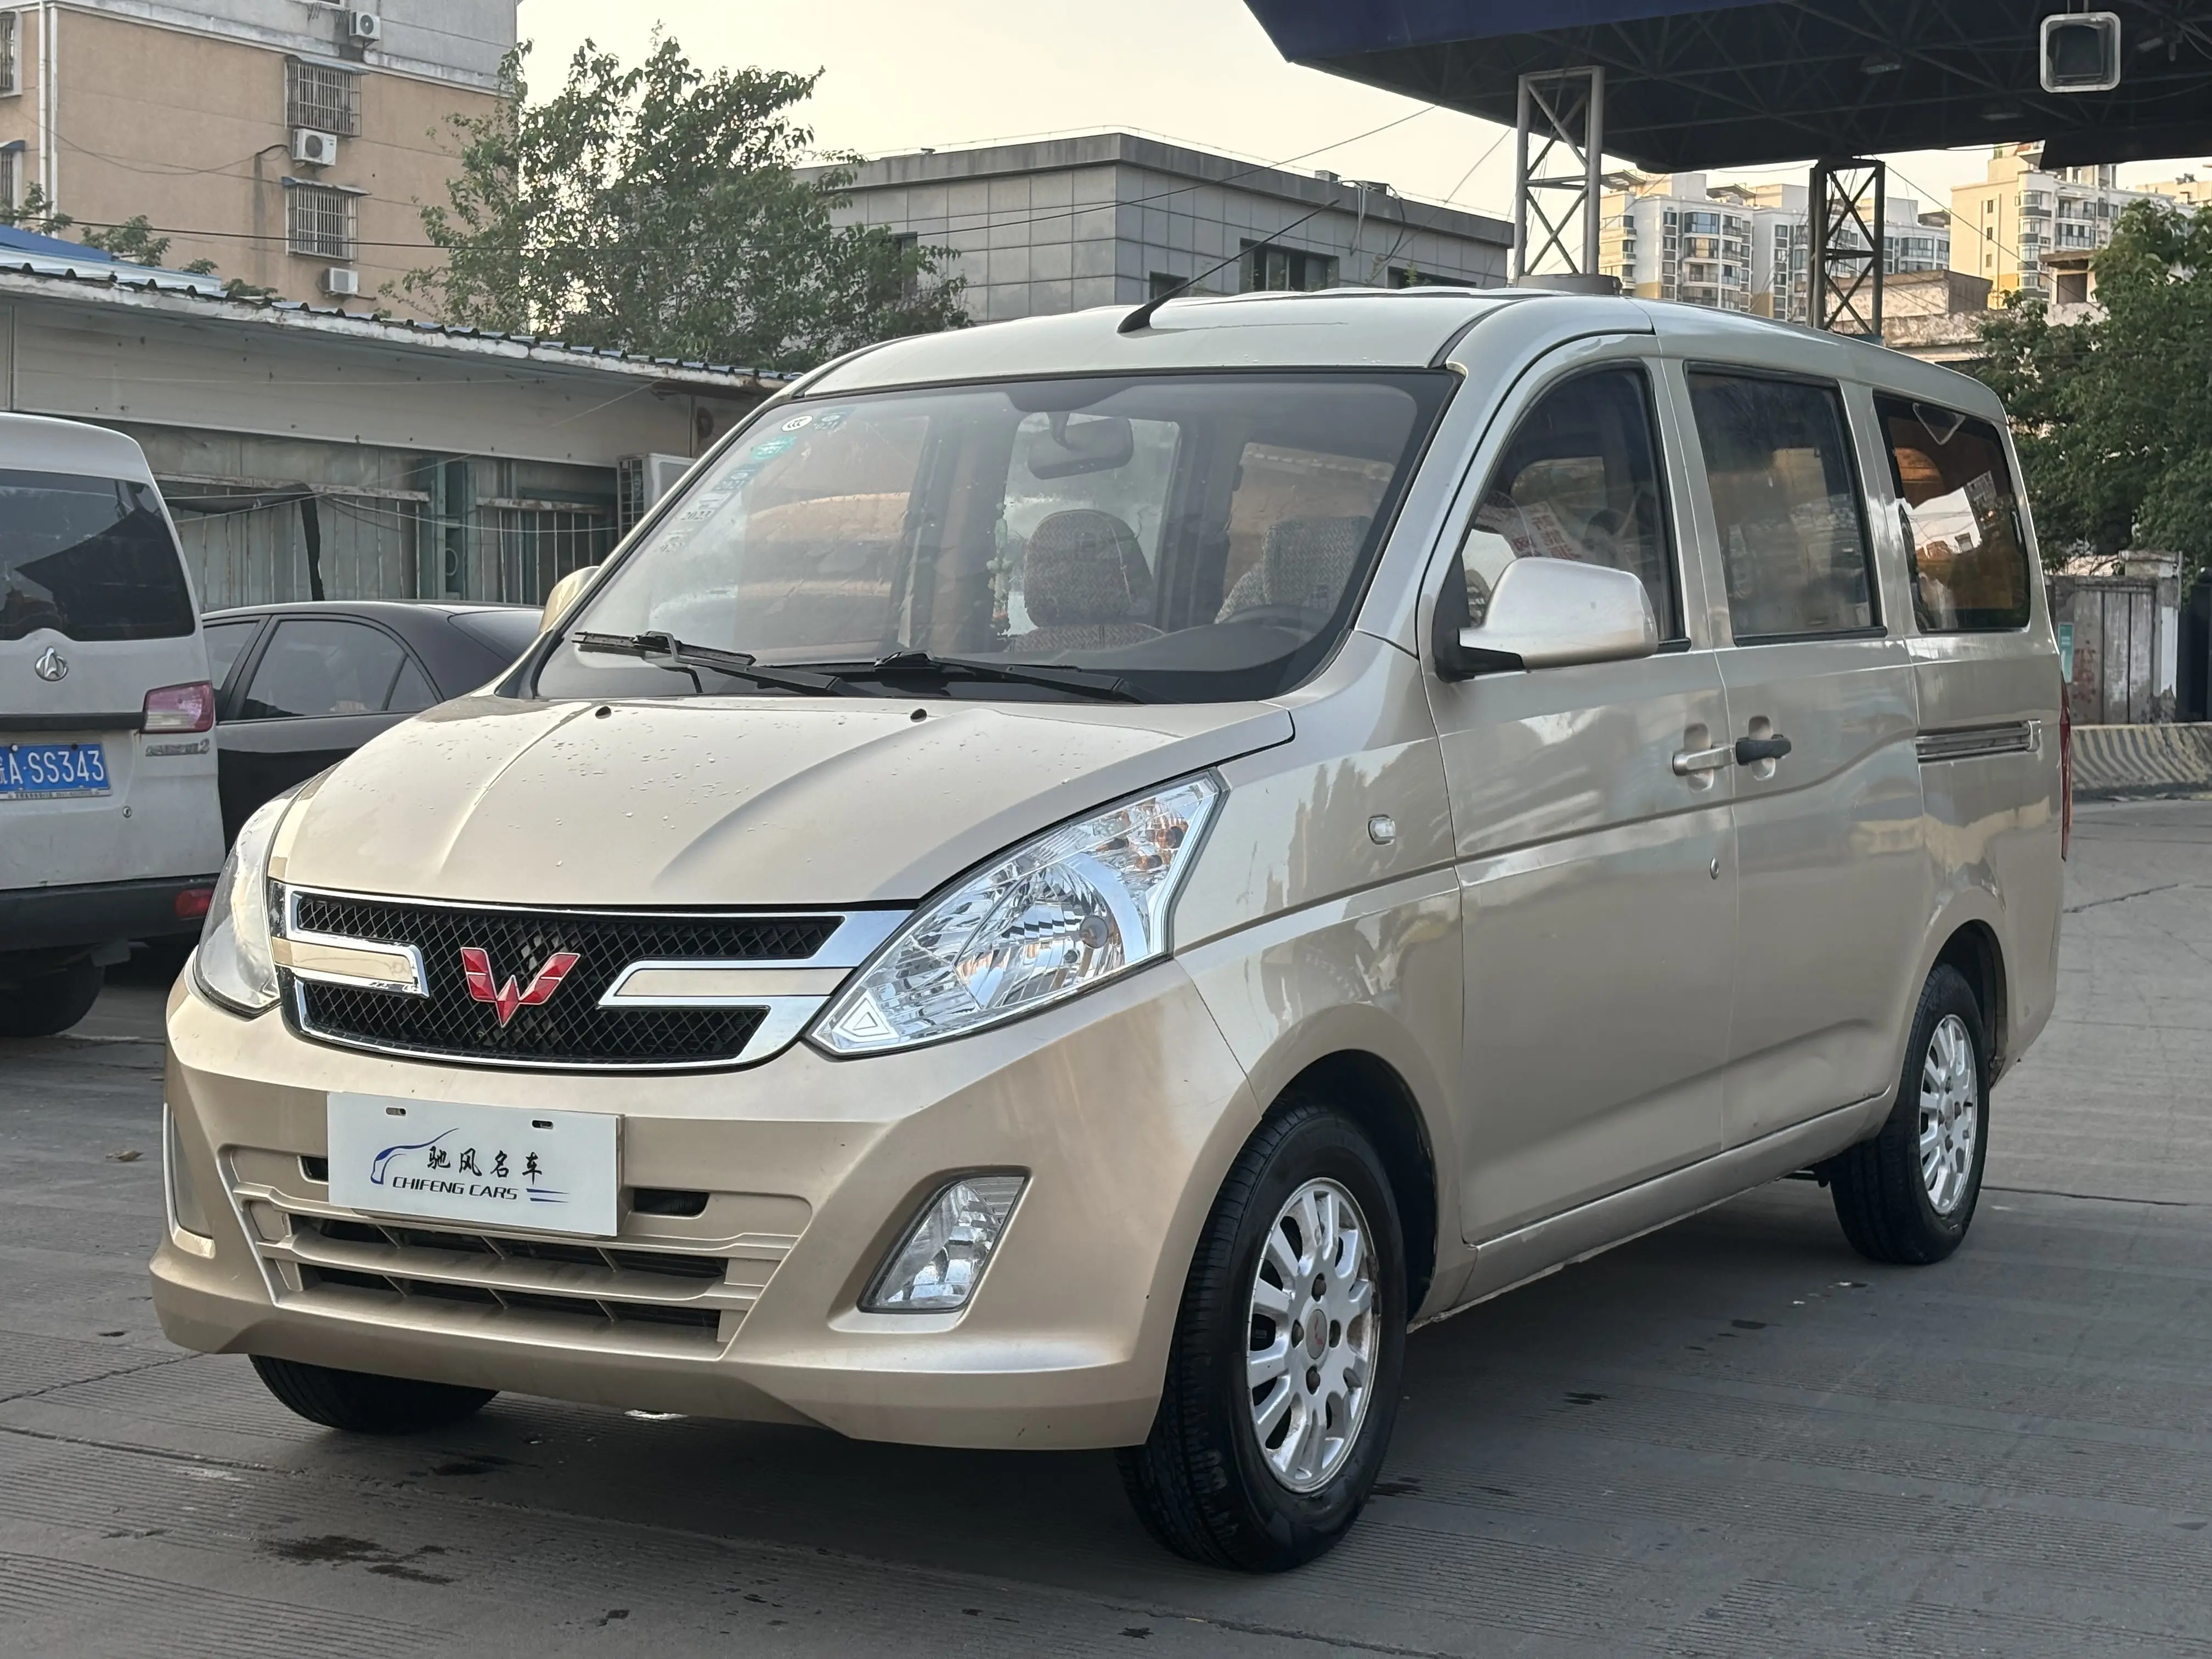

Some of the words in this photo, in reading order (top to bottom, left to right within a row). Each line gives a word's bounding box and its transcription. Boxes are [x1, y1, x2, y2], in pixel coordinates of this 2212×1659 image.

[426, 1146, 543, 1186] 驰风名车
[392, 1176, 465, 1195] CHIFENG
[469, 1184, 518, 1200] CARS
